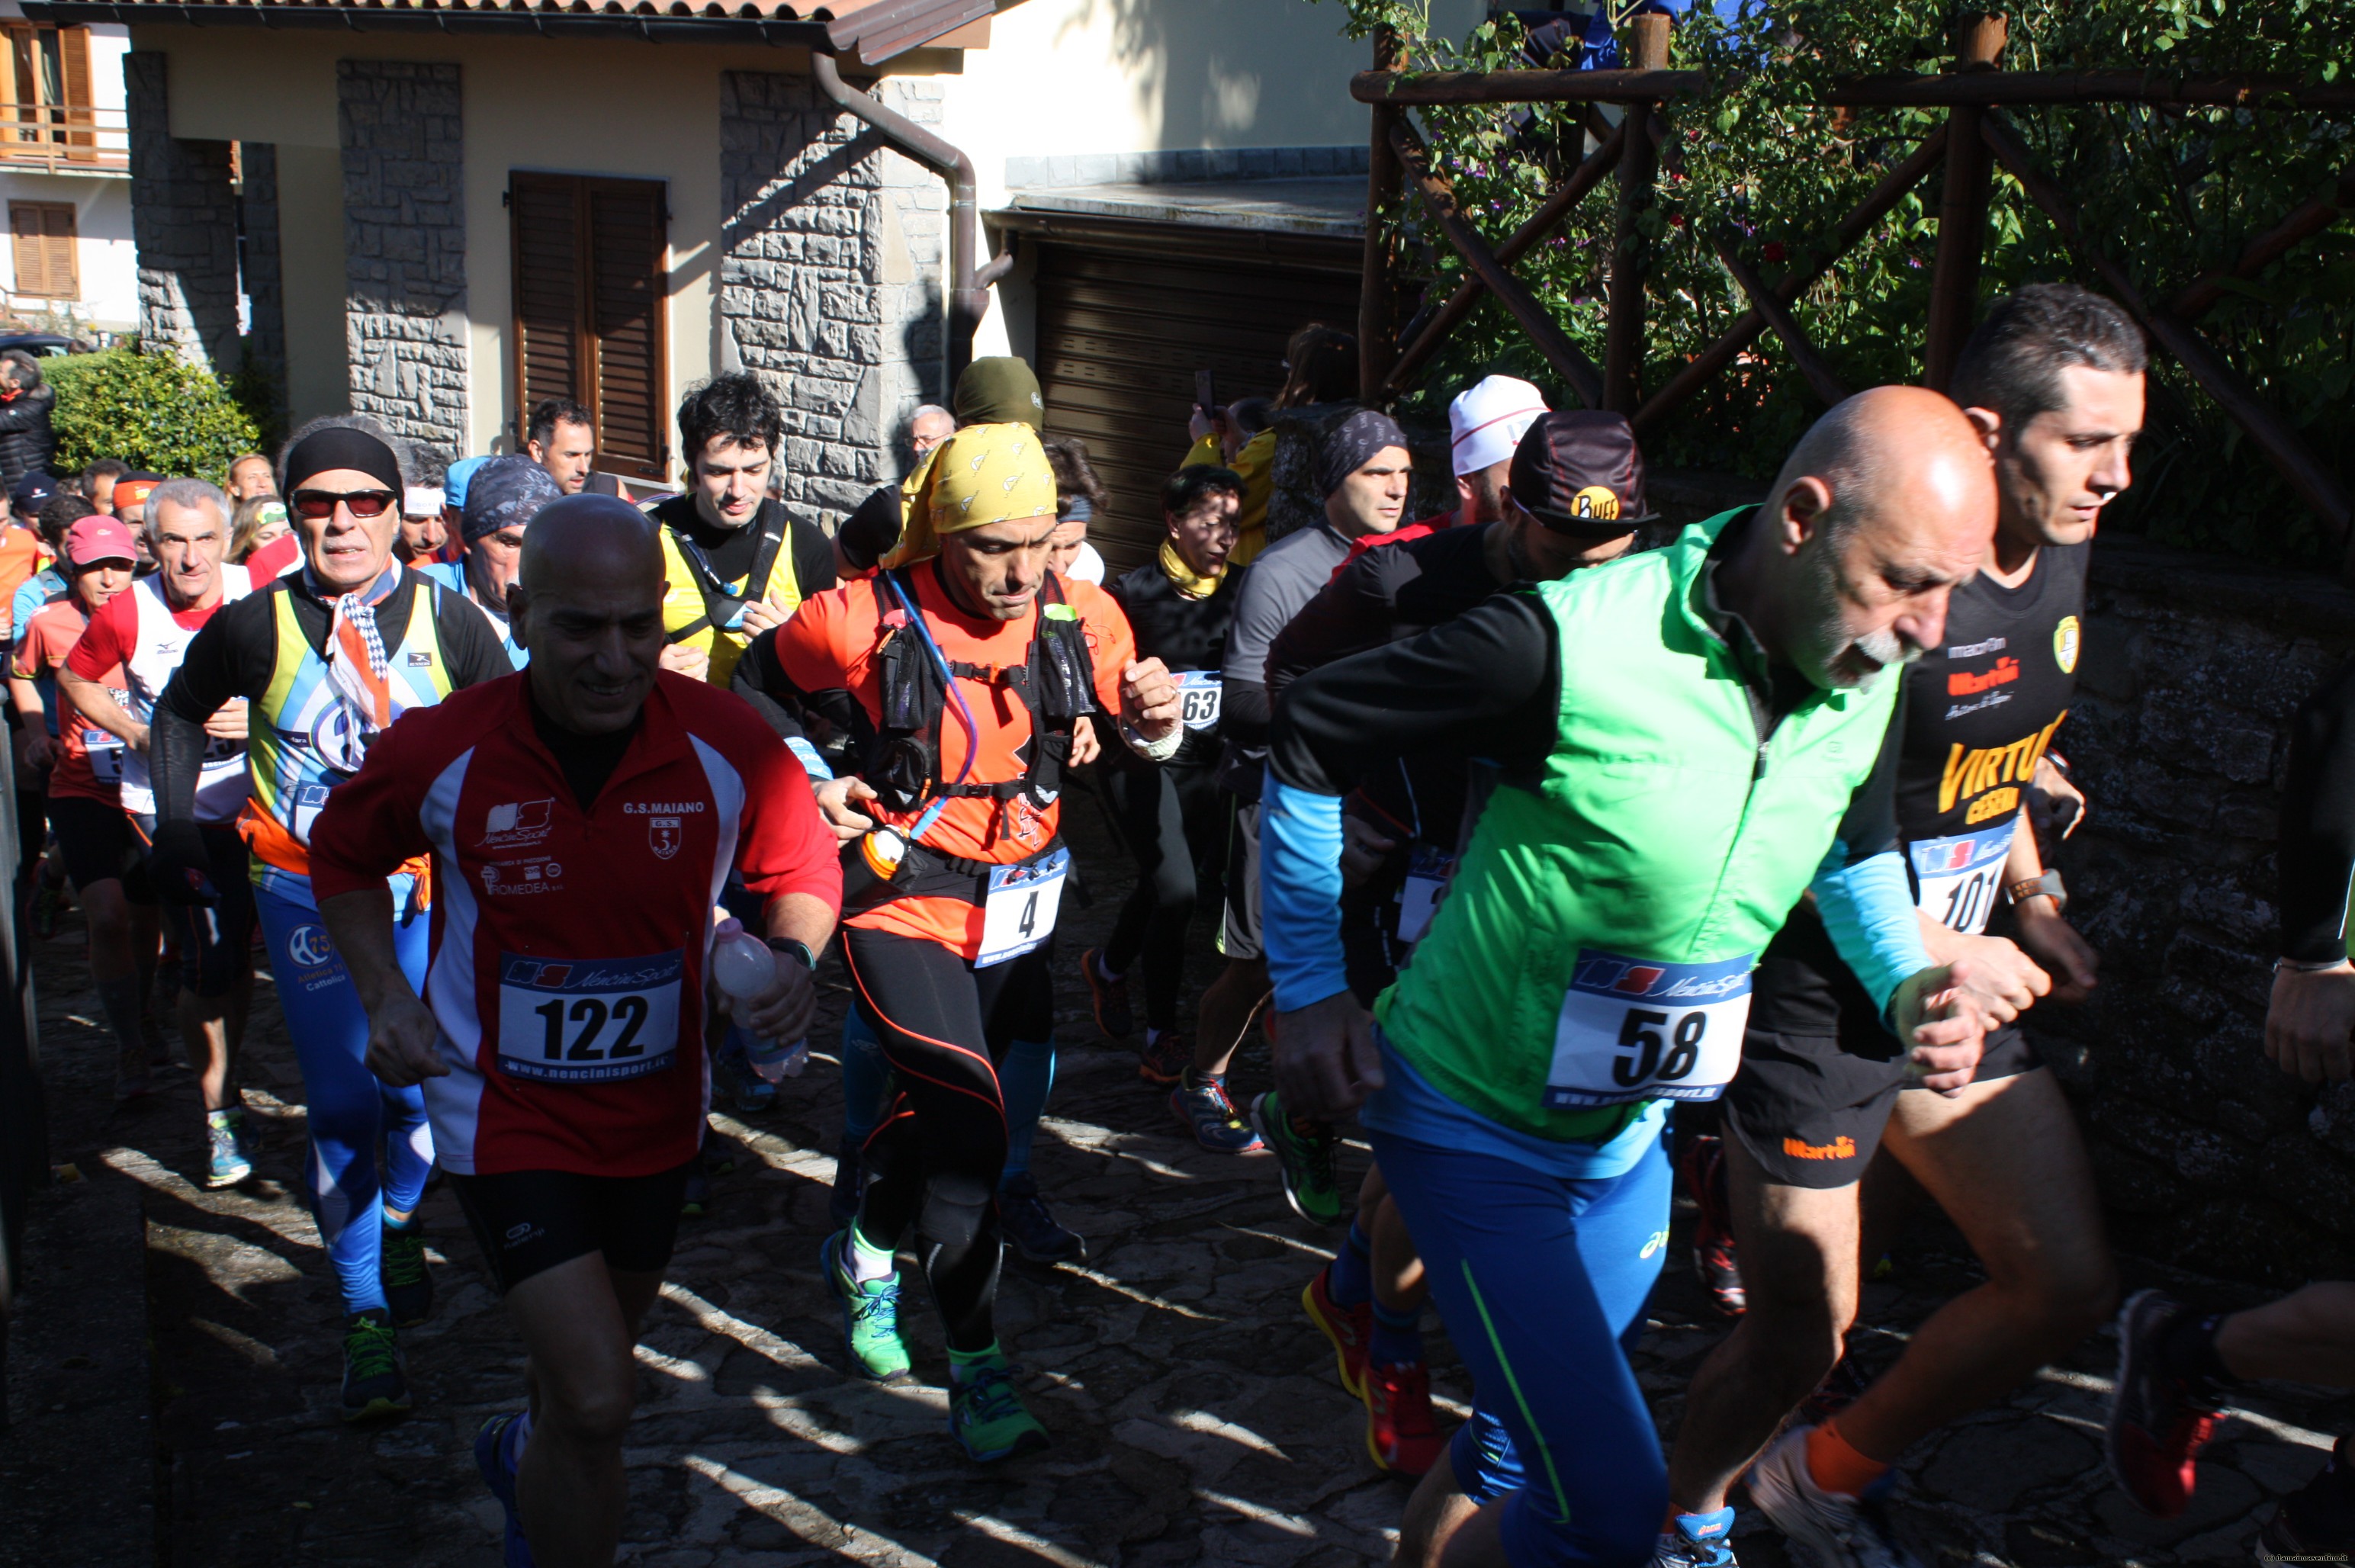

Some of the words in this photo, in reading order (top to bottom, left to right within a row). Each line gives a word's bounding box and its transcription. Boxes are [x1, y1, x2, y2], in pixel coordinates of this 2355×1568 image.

[623, 802, 705, 814] G.S.MAIANO
[1019, 891, 1039, 939] 4
[306, 974, 346, 991] Cattolica
[535, 995, 648, 1061] 122
[1612, 1007, 1707, 1088] 58
